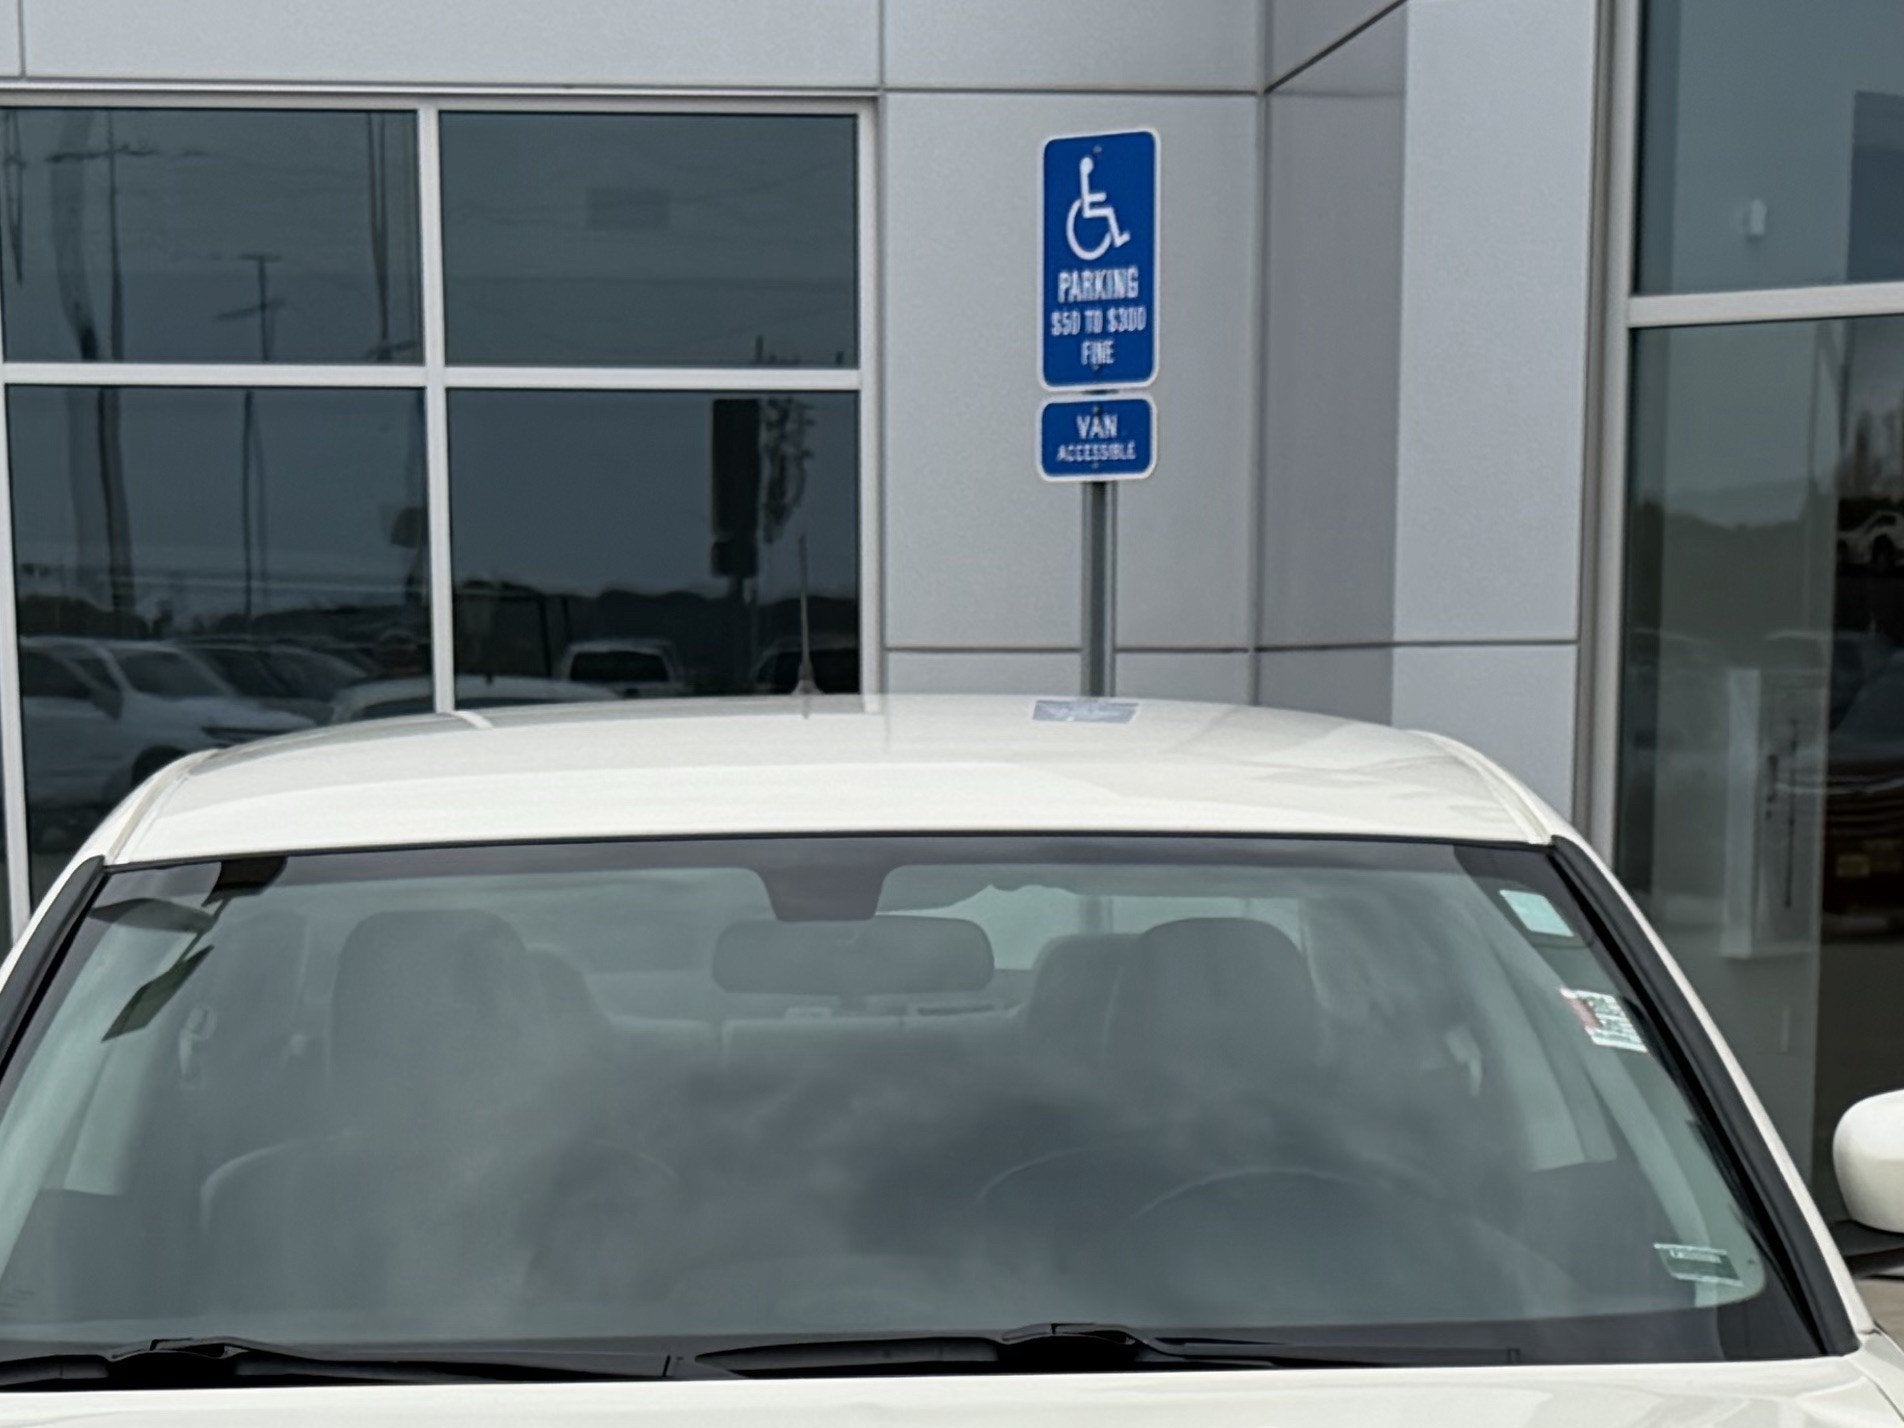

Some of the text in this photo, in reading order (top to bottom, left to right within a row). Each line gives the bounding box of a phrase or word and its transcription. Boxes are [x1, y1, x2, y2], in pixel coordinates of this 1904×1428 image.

[1058, 266, 1139, 303] PARKING
[1051, 306, 1147, 336] $50 TO $300
[1080, 340, 1114, 366] FINE
[1077, 414, 1118, 440] VAN
[1057, 441, 1136, 462] ACCESSIBLE
